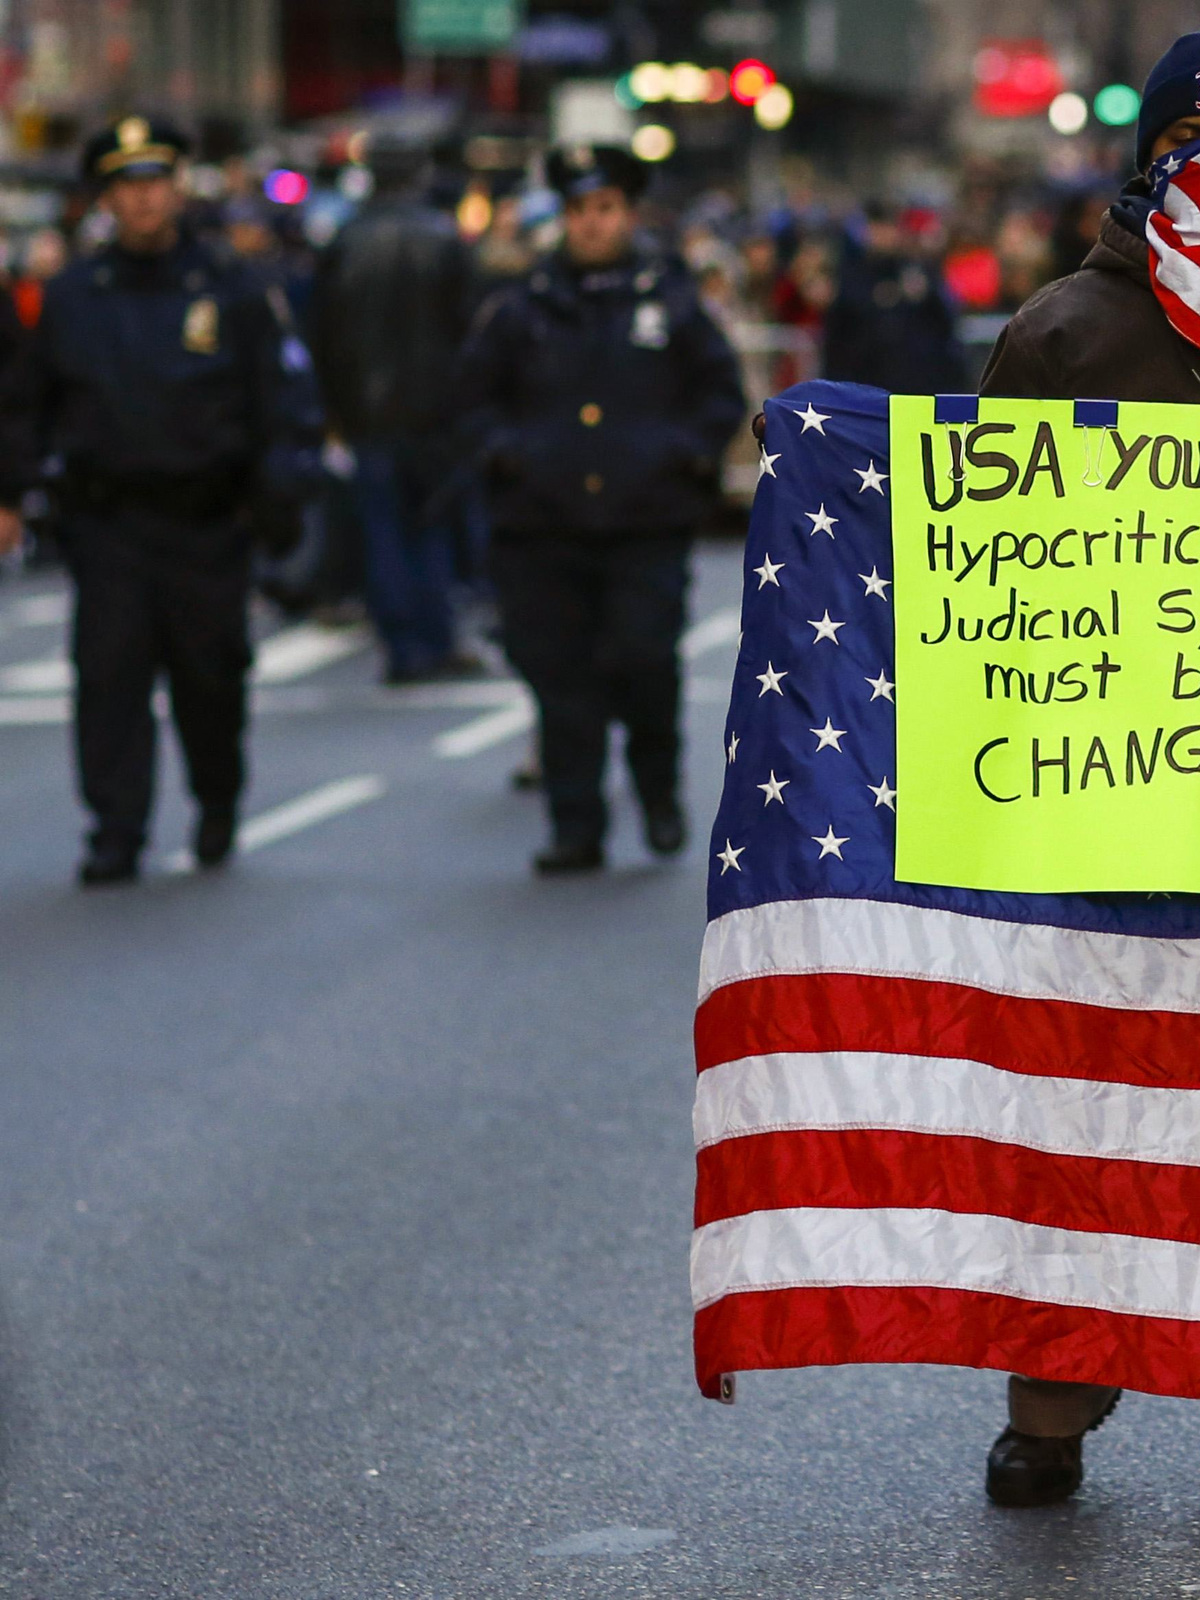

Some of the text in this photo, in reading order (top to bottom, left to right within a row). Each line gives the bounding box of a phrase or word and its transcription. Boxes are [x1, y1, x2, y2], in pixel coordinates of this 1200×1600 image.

[921, 421, 1065, 511] USA
[921, 587, 1120, 645] Judicial
[985, 651, 1121, 704] must
